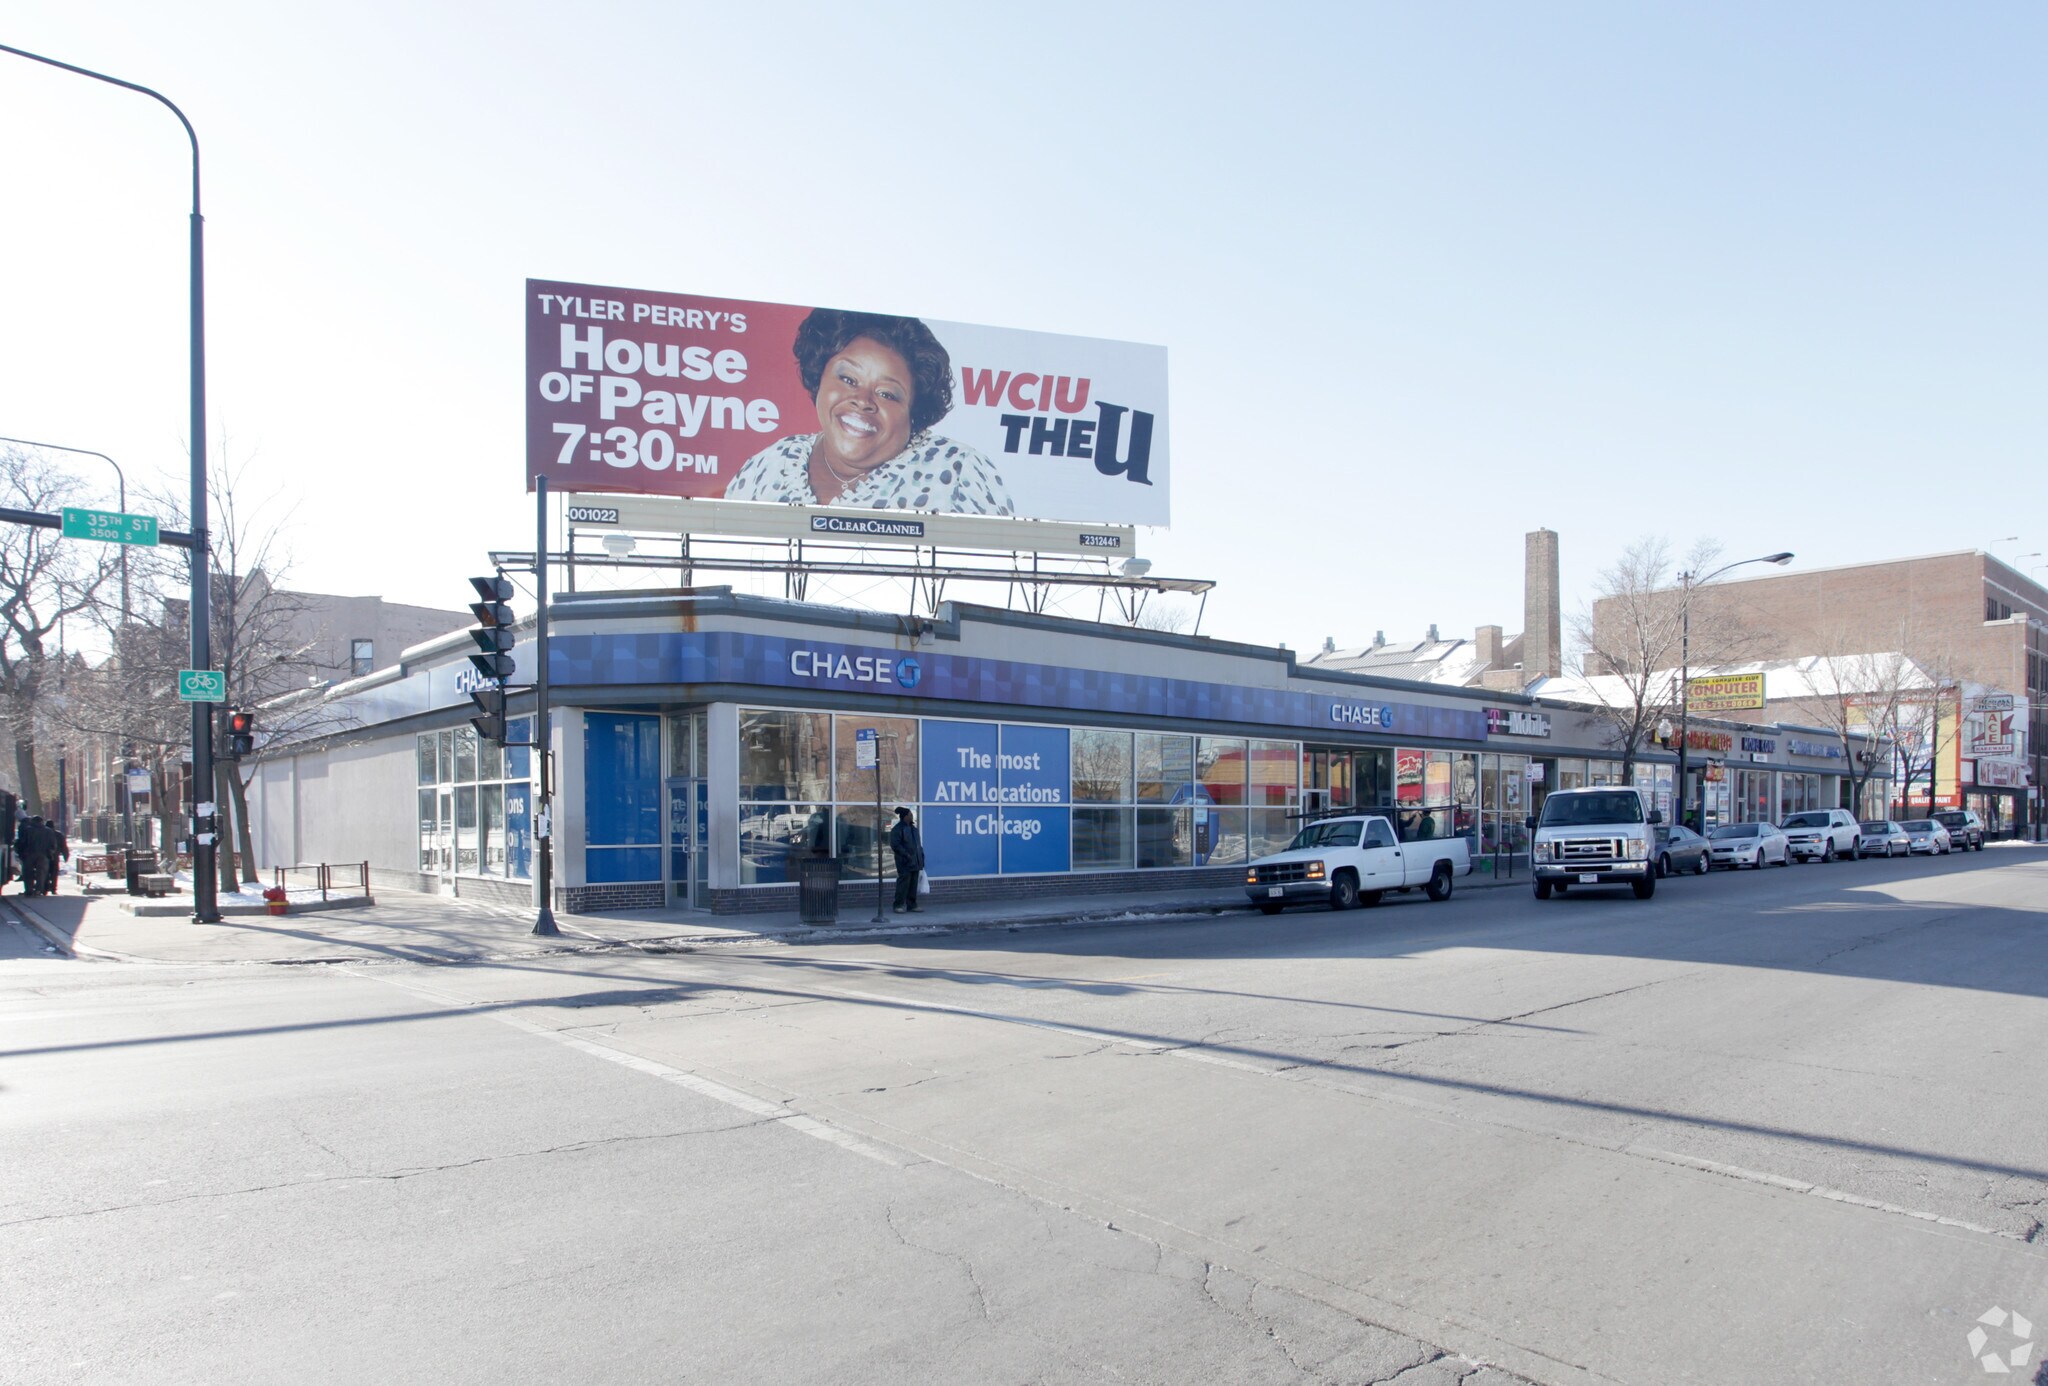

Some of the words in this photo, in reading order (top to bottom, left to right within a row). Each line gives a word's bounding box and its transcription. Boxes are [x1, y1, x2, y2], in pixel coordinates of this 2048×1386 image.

[538, 294, 625, 321] TYLER
[633, 303, 748, 333] PERRY'S
[560, 323, 748, 383] House
[961, 367, 1091, 413] WCIU
[539, 372, 594, 402] OF
[600, 375, 780, 437] Payne
[1000, 414, 1096, 459] THE
[69, 513, 76, 522] E
[87, 514, 122, 527] 35TH
[132, 519, 150, 531] ST
[569, 508, 617, 522] 001022
[90, 528, 119, 539] 3500
[125, 532, 132, 540] S
[791, 650, 892, 683] CHASE
[1688, 682, 1758, 697] COMPUTER
[1331, 704, 1380, 725] CHASE
[1988, 713, 1998, 743] ACE
[957, 747, 991, 768] The
[996, 752, 1041, 770] most
[934, 781, 977, 801] ATM
[982, 781, 1060, 802] locations
[956, 814, 972, 834] in
[975, 814, 1041, 840] Chicago
